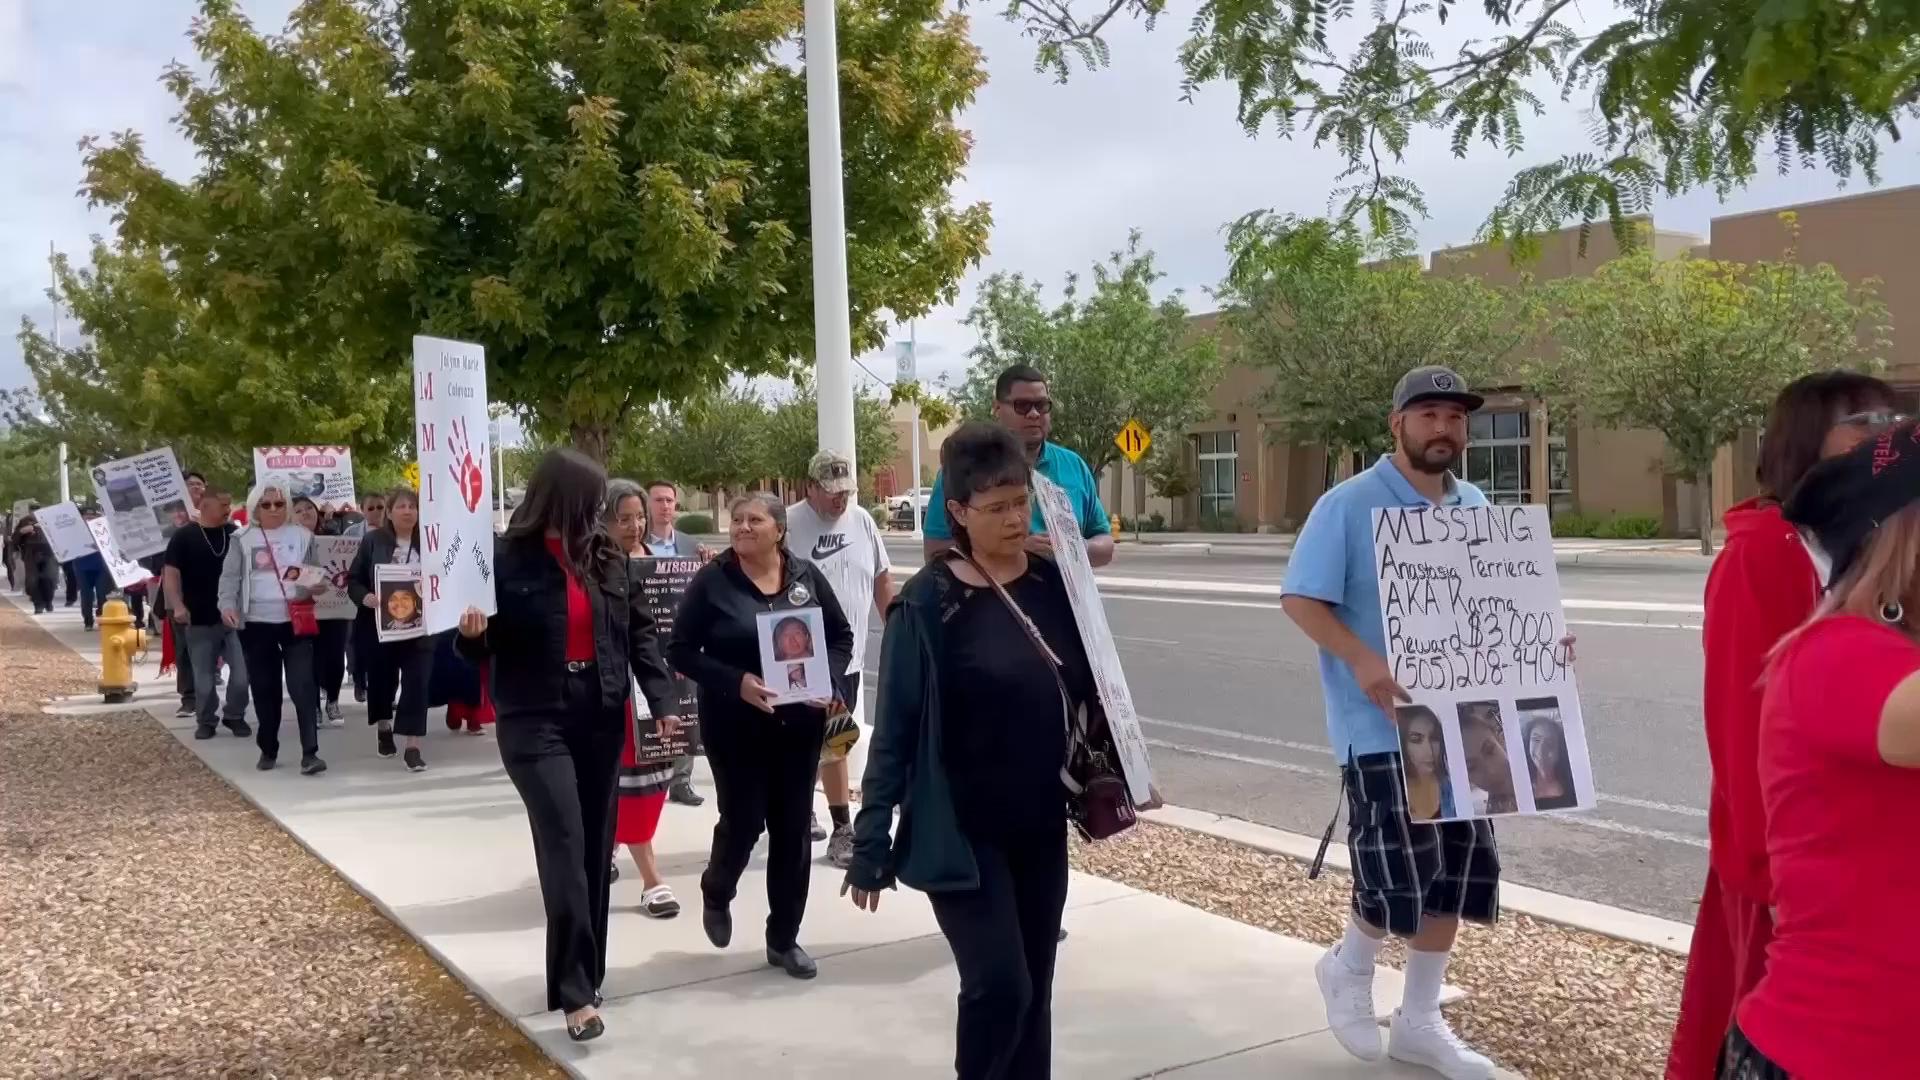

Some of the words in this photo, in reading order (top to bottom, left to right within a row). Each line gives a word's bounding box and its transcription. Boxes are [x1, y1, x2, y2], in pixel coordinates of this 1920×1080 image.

[817, 533, 847, 549] NIKE
[1375, 506, 1534, 546] MISSING
[654, 560, 703, 575] MISSIN
[1380, 544, 1461, 581] Anastasia
[1386, 579, 1441, 616] AKA
[1387, 615, 1462, 654] Reward
